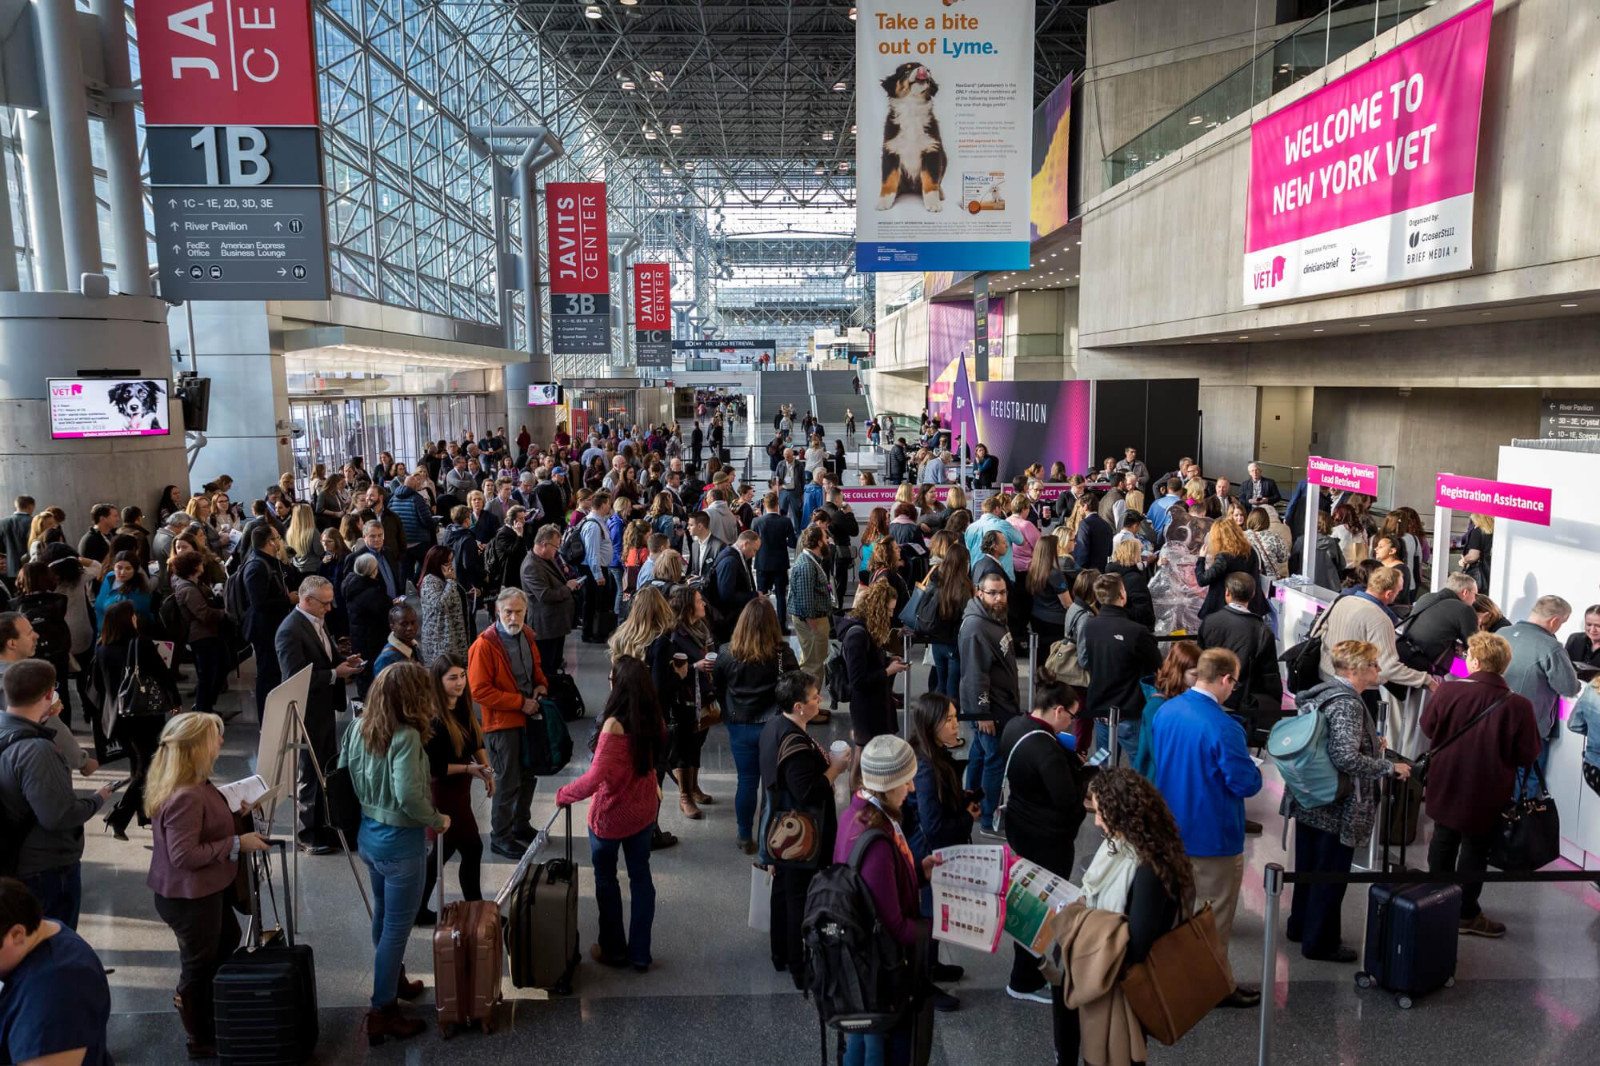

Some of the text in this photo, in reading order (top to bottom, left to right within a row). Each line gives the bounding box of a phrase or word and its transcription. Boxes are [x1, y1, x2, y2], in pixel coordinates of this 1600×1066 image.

[875, 13, 979, 30] Take a bite
[878, 38, 998, 58] out of Lyme.
[1284, 72, 1424, 166] WELCOME TO
[190, 126, 271, 185] 1B
[1272, 123, 1437, 215] NEW YORK VET
[183, 199, 196, 208] 1C
[207, 199, 221, 209] 1E,
[224, 199, 240, 209] 2D,
[242, 199, 258, 209] 3D,
[260, 199, 273, 208] 3E
[185, 222, 248, 231] River Pavilion
[256, 242, 286, 250] Express
[557, 197, 577, 279] JAVITS
[582, 196, 599, 279] CENTER
[257, 250, 286, 258] Lounge
[1407, 246, 1451, 264] BRIEF MEDIA
[1254, 270, 1271, 290] VET
[565, 294, 596, 315] 3B
[640, 272, 653, 321] JAVITS
[655, 271, 665, 322] CENTER
[643, 330, 663, 343] 1C
[990, 400, 1047, 425] REGISTRATION
[1310, 460, 1375, 479] Exhibitor Badge Queries
[1321, 474, 1361, 489] Lead Retrieval
[1440, 484, 1544, 512] Registration Assistance
